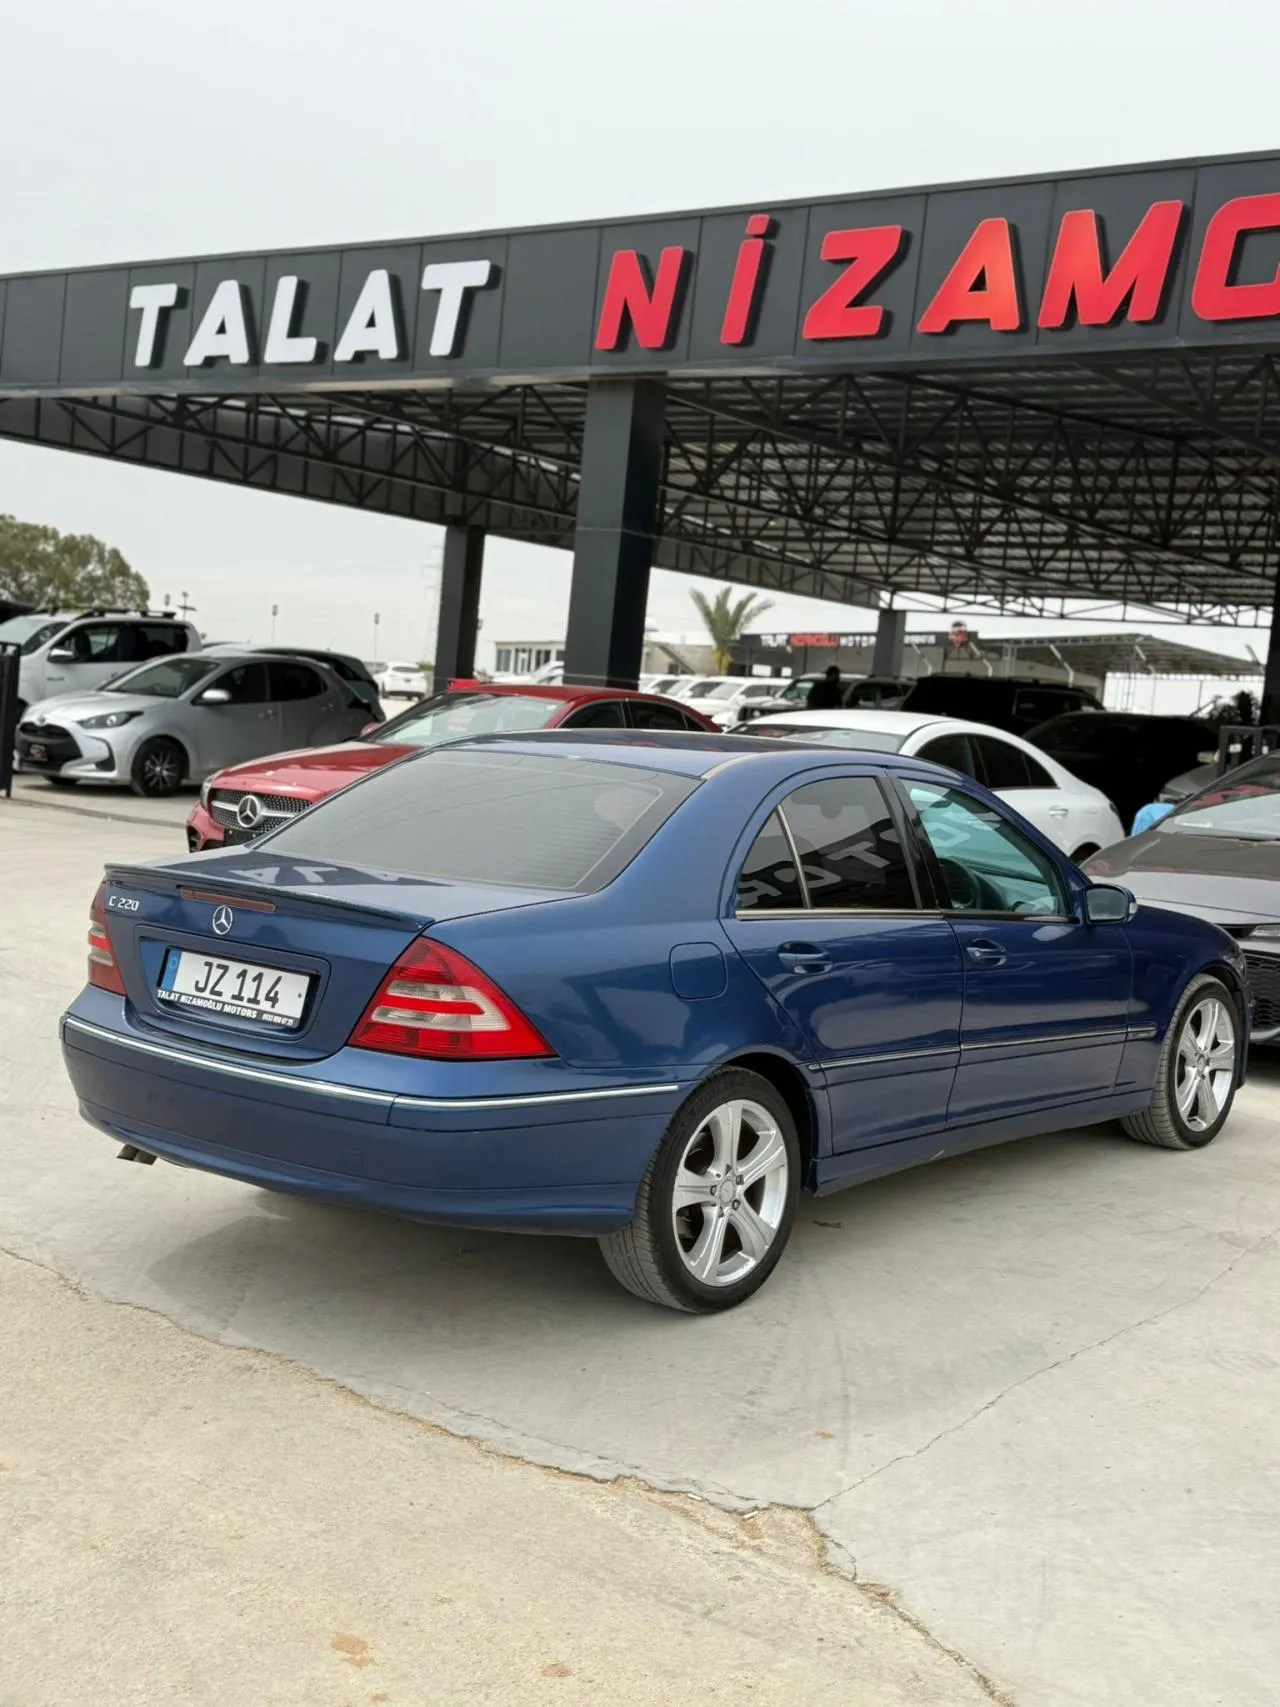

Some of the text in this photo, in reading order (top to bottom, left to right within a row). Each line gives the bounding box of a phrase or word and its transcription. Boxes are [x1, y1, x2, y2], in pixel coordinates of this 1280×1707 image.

[130, 259, 491, 367] TALAT
[108, 895, 140, 911] C 220
[157, 989, 180, 1002] TALAT
[223, 1004, 258, 1019] MOTORS
[194, 961, 282, 1009] JZ 114
